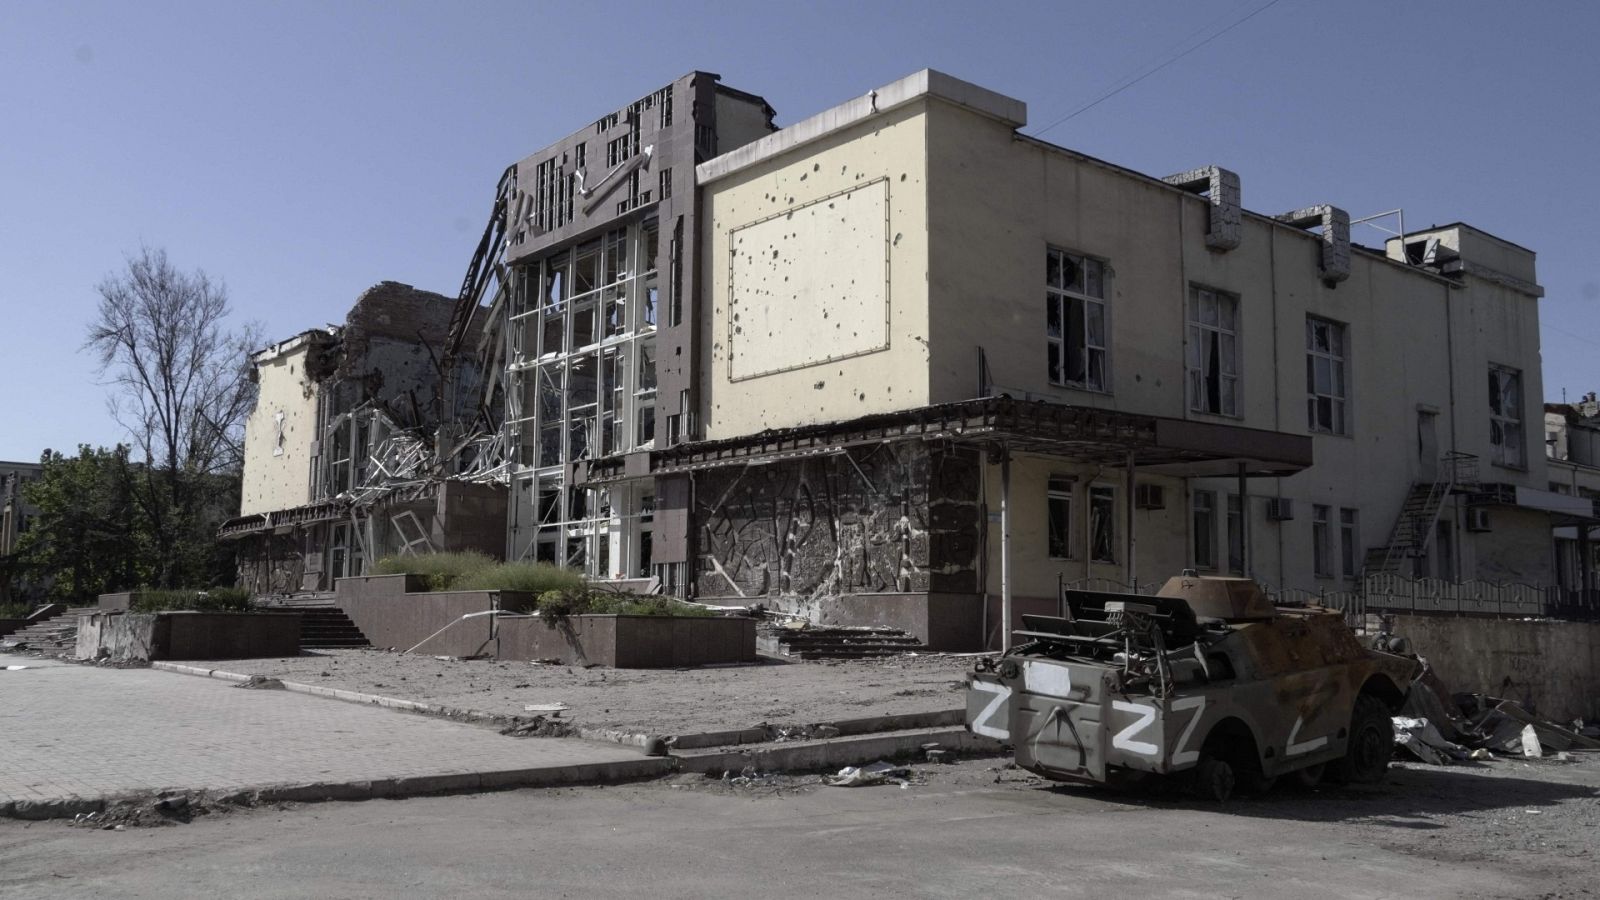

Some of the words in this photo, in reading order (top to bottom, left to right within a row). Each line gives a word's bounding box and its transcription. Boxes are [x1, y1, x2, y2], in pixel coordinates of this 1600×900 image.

[972, 680, 1012, 740] Z
[1111, 700, 1159, 756] Z
[1171, 695, 1206, 765] Z
